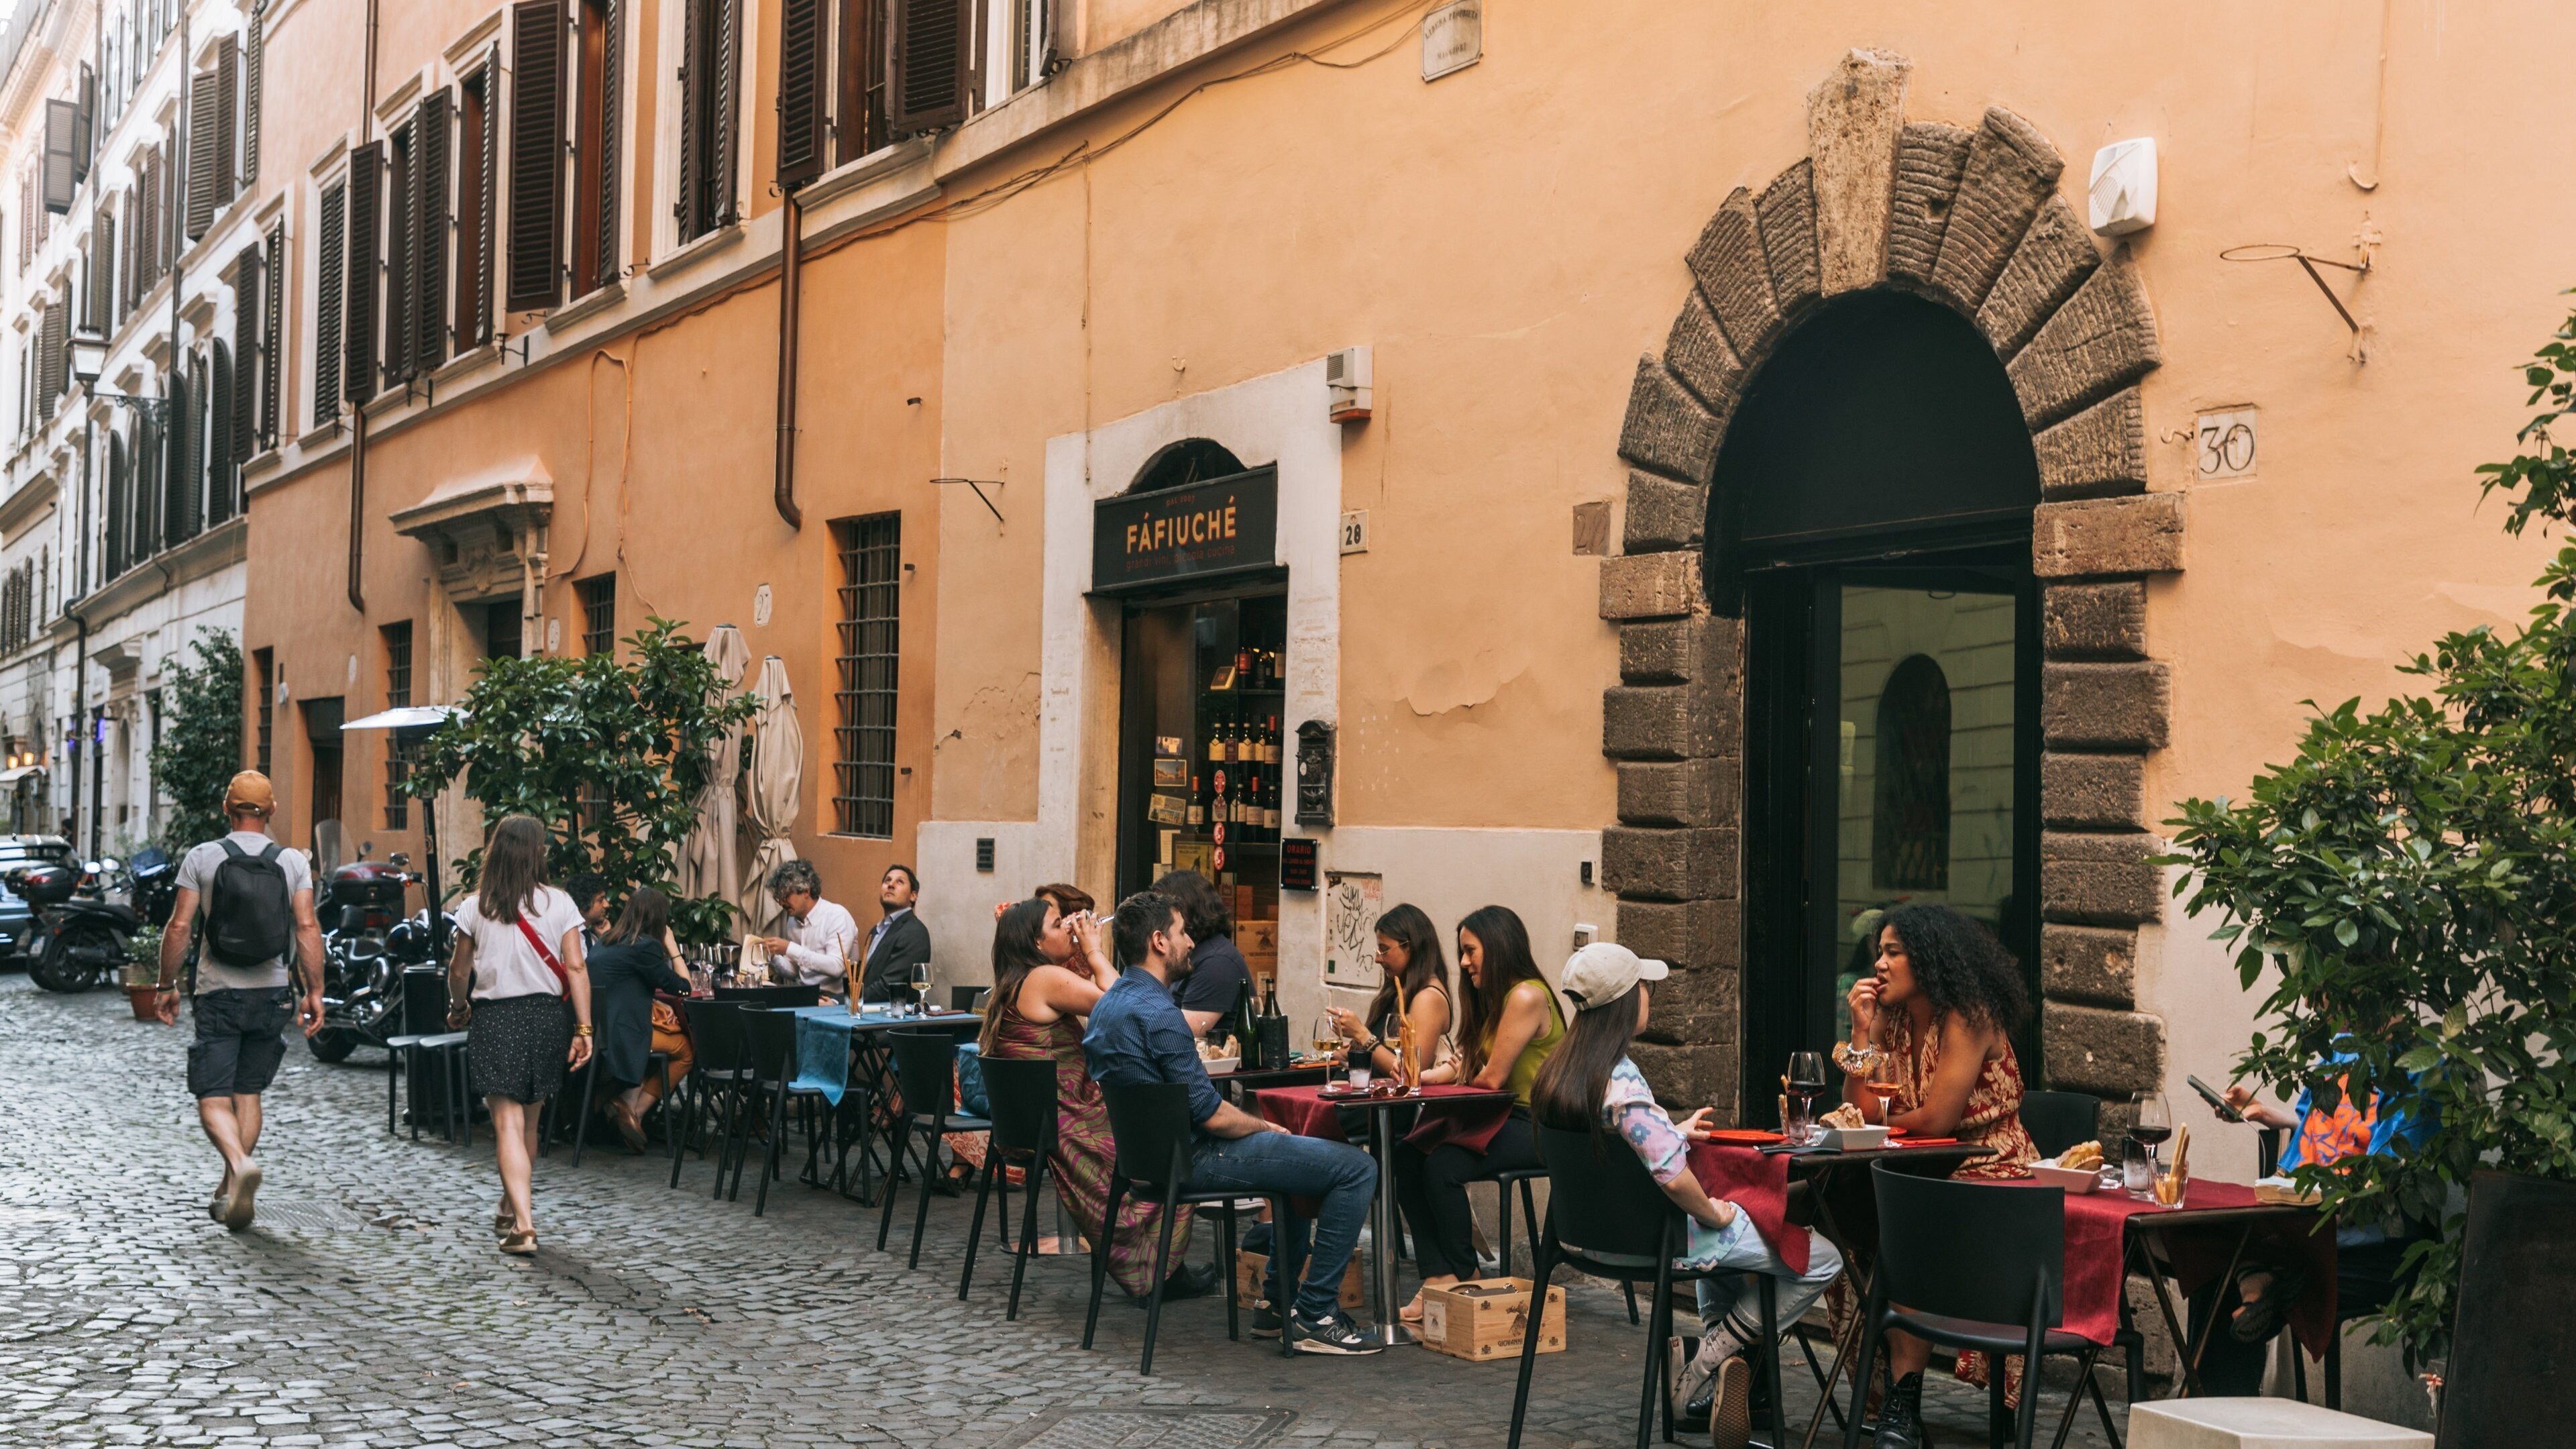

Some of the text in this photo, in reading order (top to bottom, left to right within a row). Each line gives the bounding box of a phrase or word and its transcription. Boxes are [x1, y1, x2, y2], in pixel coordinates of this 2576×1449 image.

[2200, 423, 2255, 474] 30
[1126, 495, 1236, 555] FÁFIUCHÉ
[1346, 523, 1362, 545] 28
[1126, 556, 1151, 572] grandi
[1208, 545, 1236, 559] cucina
[1287, 845, 1311, 855] ORARIO
[1497, 1338, 1523, 1347] GIOVANNI
